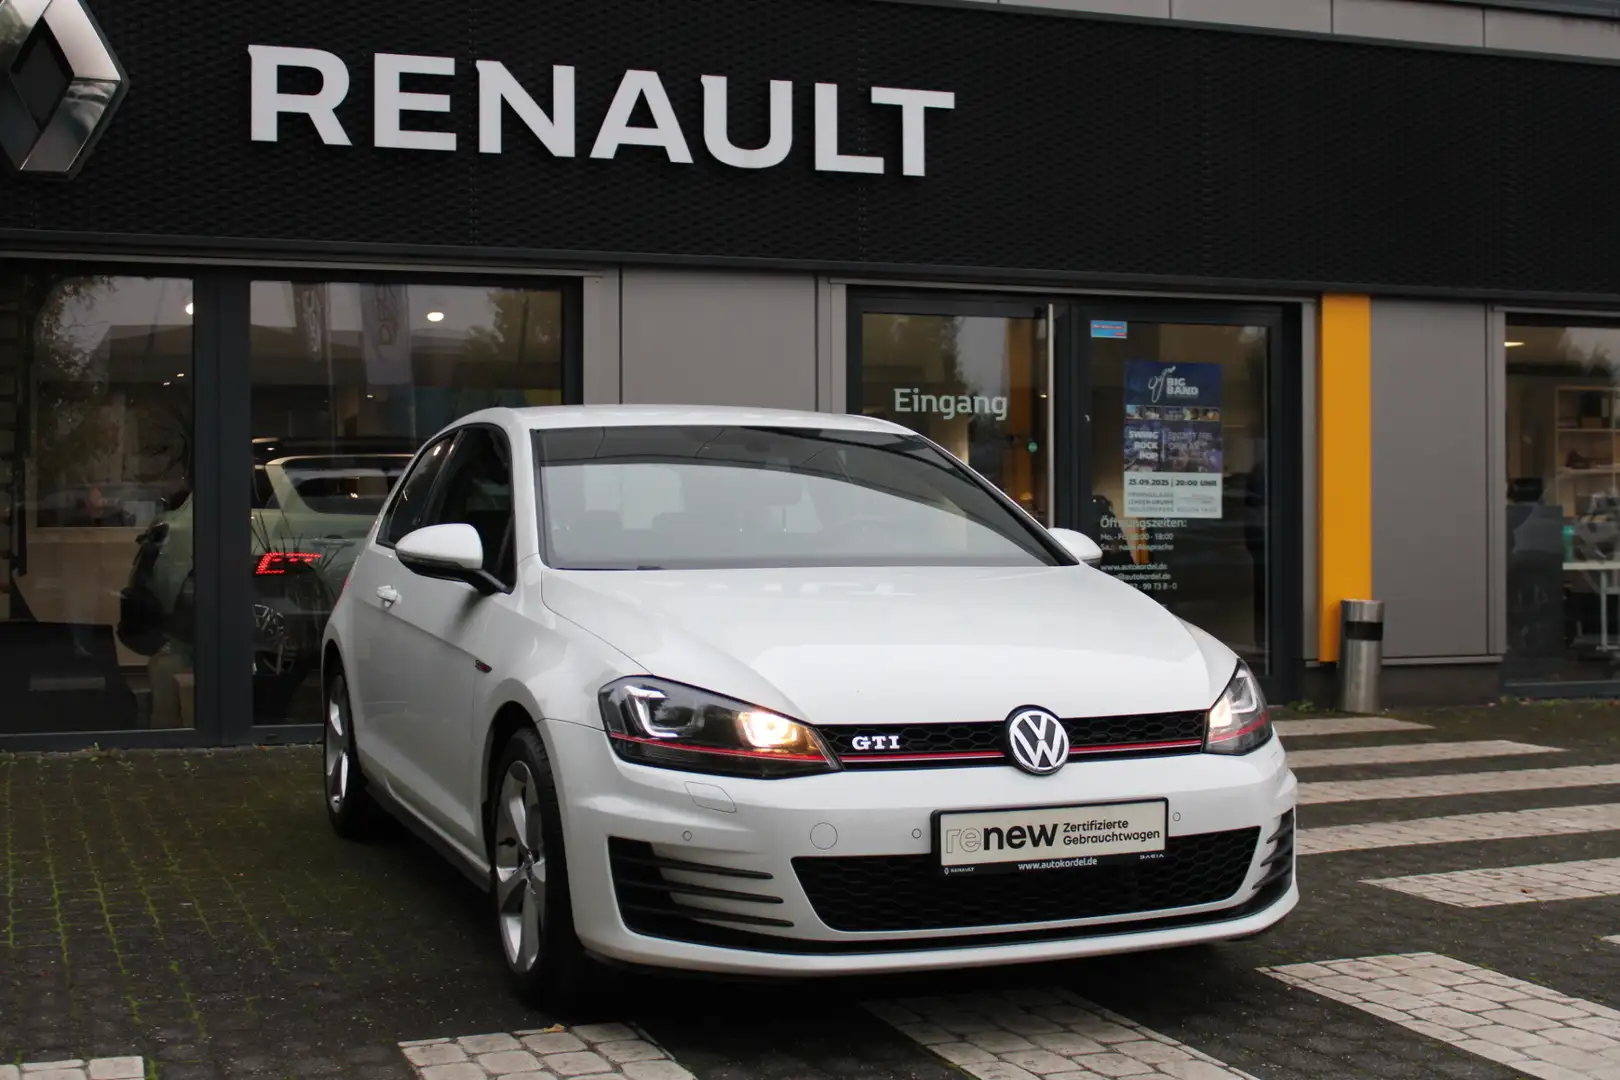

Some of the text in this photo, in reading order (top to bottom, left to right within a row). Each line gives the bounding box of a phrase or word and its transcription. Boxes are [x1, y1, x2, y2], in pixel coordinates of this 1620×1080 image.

[248, 44, 955, 177] RENAULT
[1166, 377, 1186, 386] BIG
[1166, 386, 1199, 396] BAND
[893, 387, 1008, 421] Eingang
[1175, 479, 1198, 487] 20:00
[1100, 515, 1187, 530] Öffungszeiten:
[851, 735, 900, 750] GTI
[1063, 818, 1129, 833] Zertifizierte
[945, 823, 1059, 854] renew
[1063, 829, 1160, 846] Gebrauchtwagen
[1018, 857, 1098, 871] www.autokordel.de
